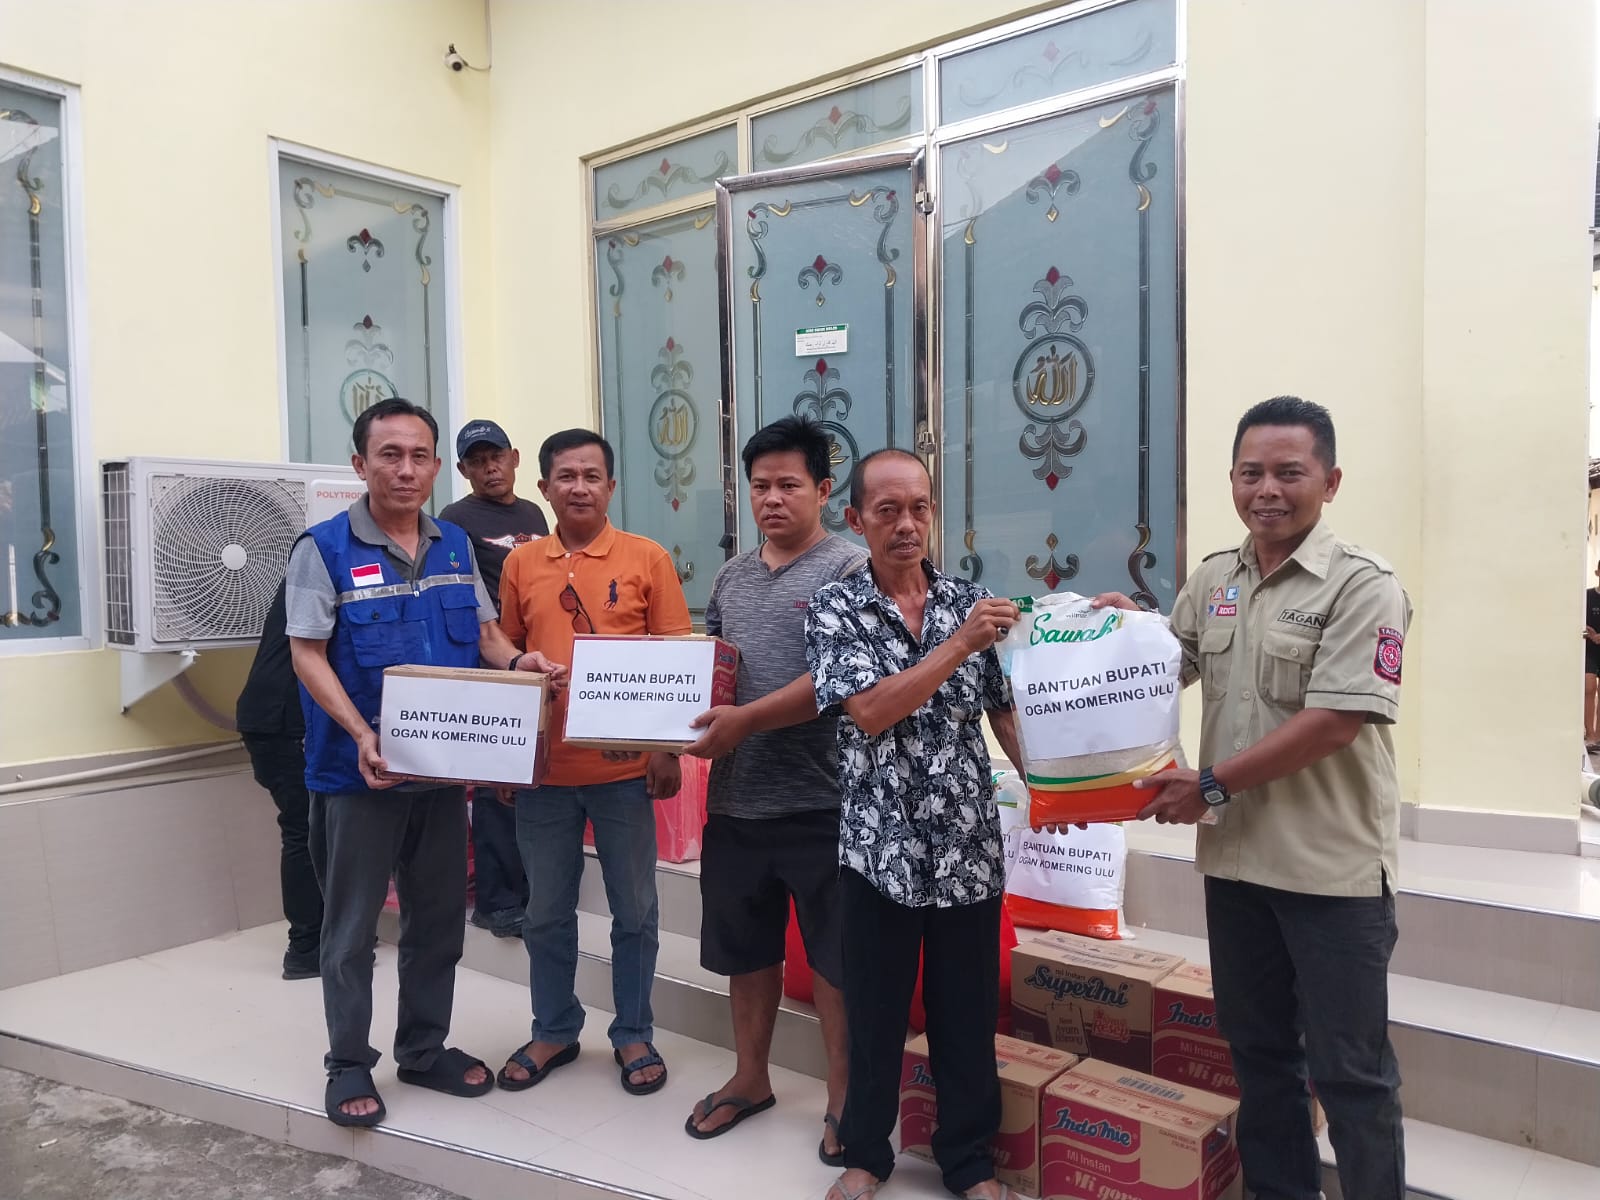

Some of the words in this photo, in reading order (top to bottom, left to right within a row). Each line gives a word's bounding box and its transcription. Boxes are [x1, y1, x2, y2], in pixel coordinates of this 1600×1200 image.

[1282, 611, 1326, 627] TAGAN
[587, 672, 646, 684] BANTUAN
[650, 674, 696, 685] BUPATI
[1028, 673, 1101, 695] BANTUAN
[1105, 662, 1166, 683] BUPATI
[579, 690, 611, 700] OGAN
[613, 691, 674, 702] KOMERING
[677, 692, 701, 703] ULU
[1025, 702, 1062, 716] OGAN
[1065, 688, 1145, 711] KOMERING
[1149, 682, 1174, 698] ULU
[400, 710, 468, 724] BANTUAN
[471, 715, 522, 729] BUPATI
[391, 728, 428, 740] OGAN
[431, 730, 498, 744] KOMERING
[501, 735, 527, 746] ULU
[1023, 841, 1065, 856] BANTUAN
[1068, 847, 1112, 862] BUPATI
[1019, 855, 1038, 866] OGAN
[1039, 860, 1092, 875] KOMERING
[1095, 867, 1115, 878] ULU
[1163, 1000, 1216, 1029] Indo
[1080, 1153, 1111, 1173] Instan
